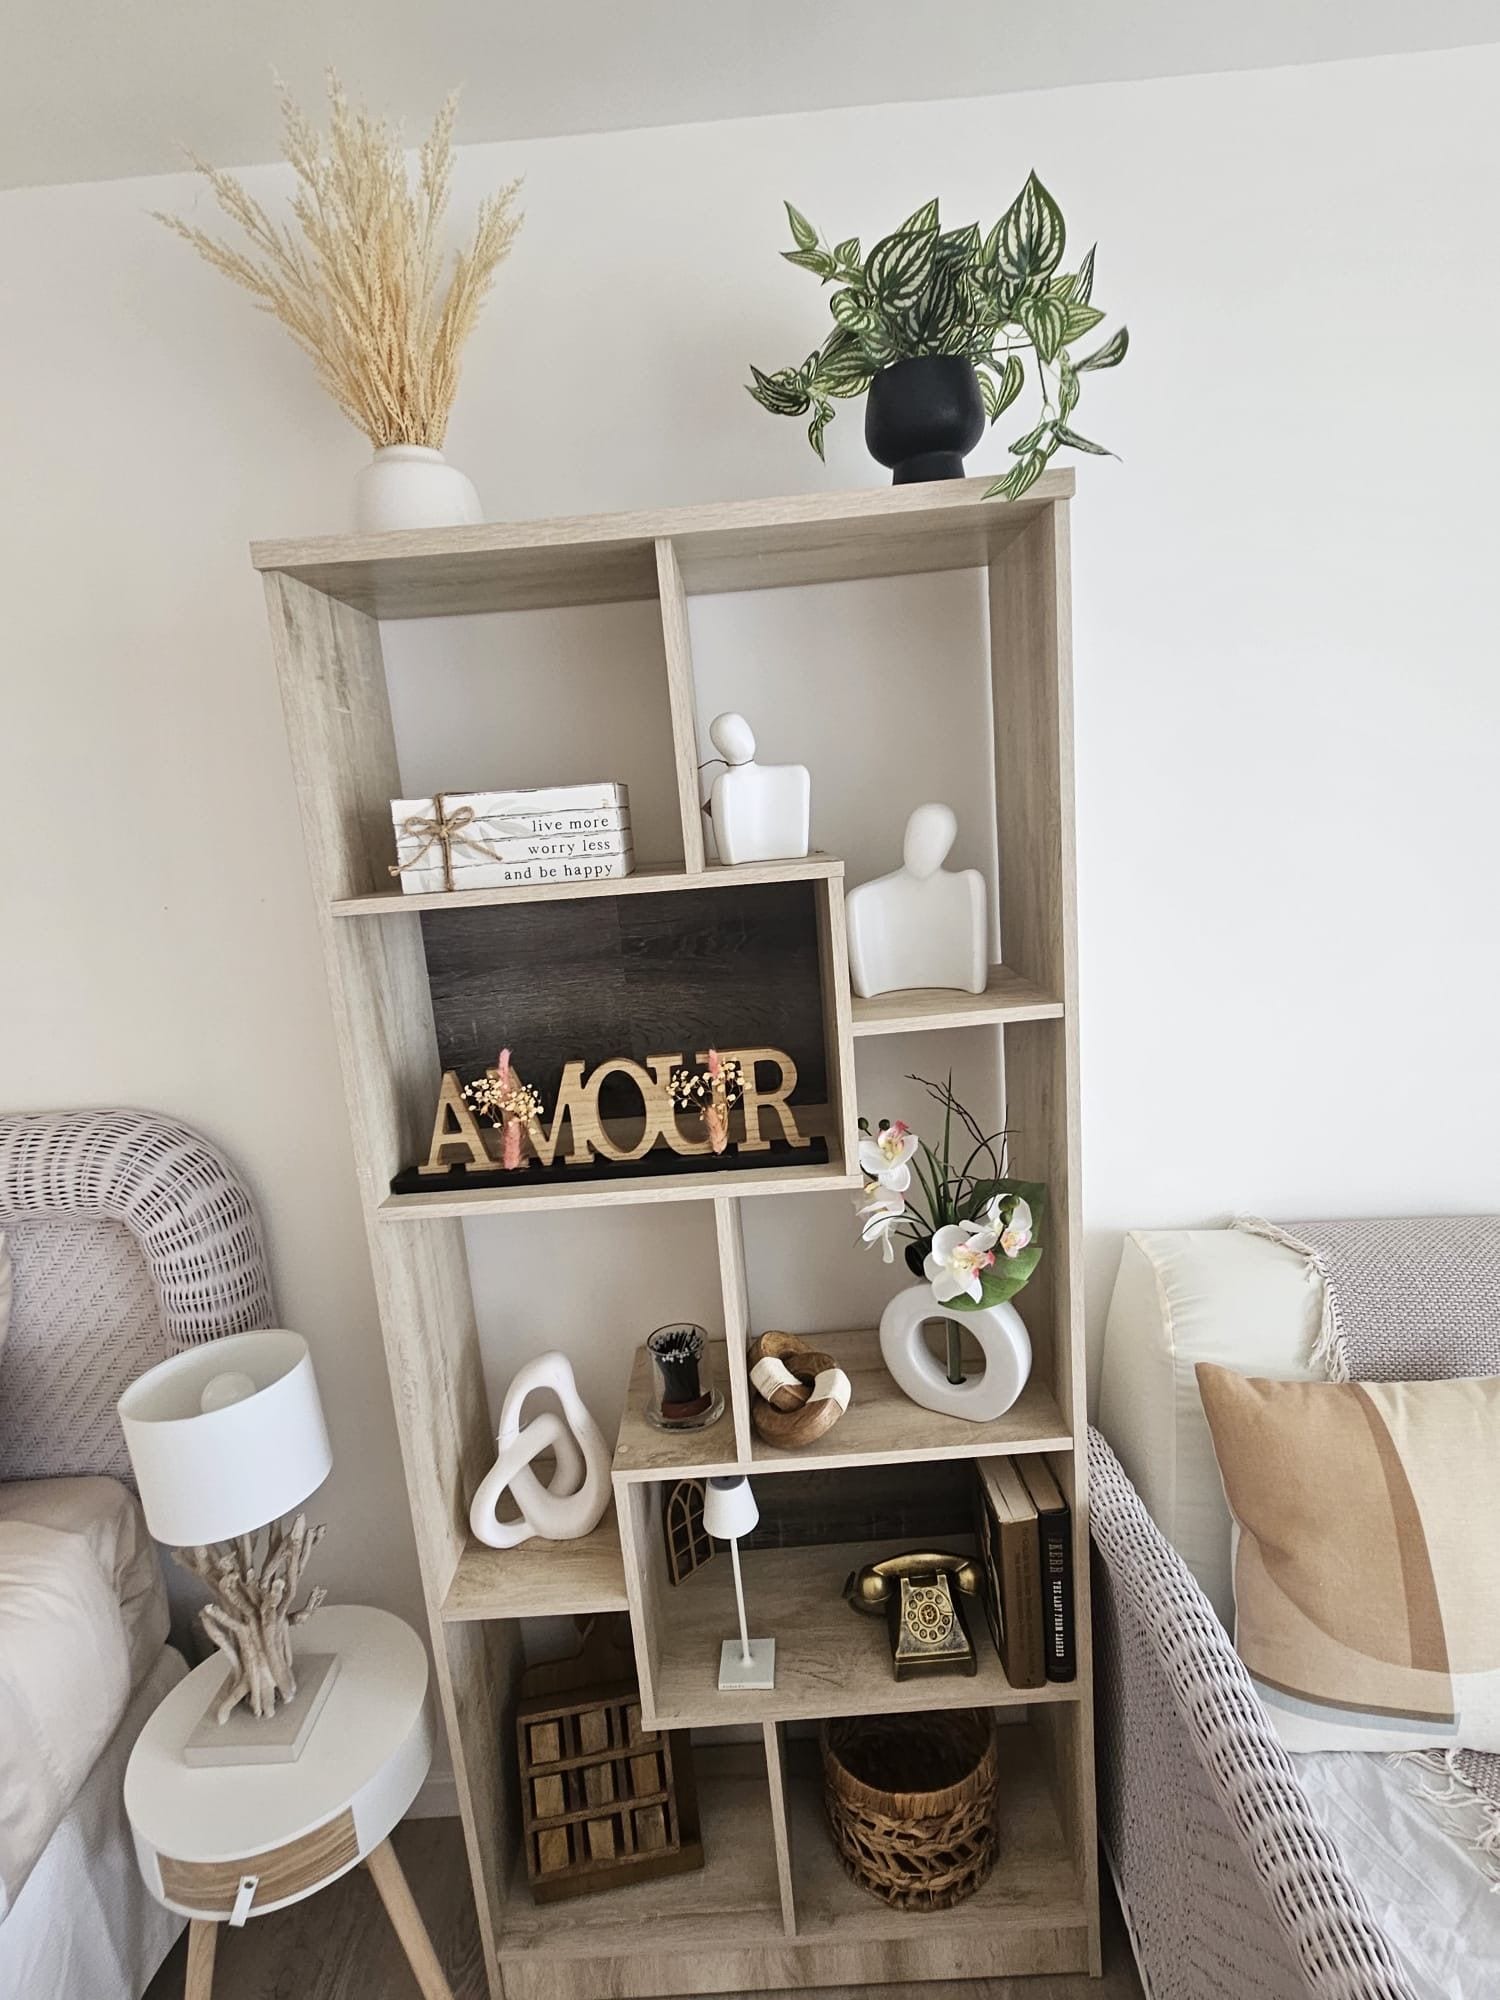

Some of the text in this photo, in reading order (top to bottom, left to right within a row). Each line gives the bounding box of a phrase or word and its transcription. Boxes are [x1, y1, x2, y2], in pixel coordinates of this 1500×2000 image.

[532, 818, 609, 832] live more
[528, 839, 611, 856] worry less
[504, 864, 613, 880] and be happy
[418, 1047, 811, 1175] AMOUR
[1053, 1580, 1062, 1594] THE
